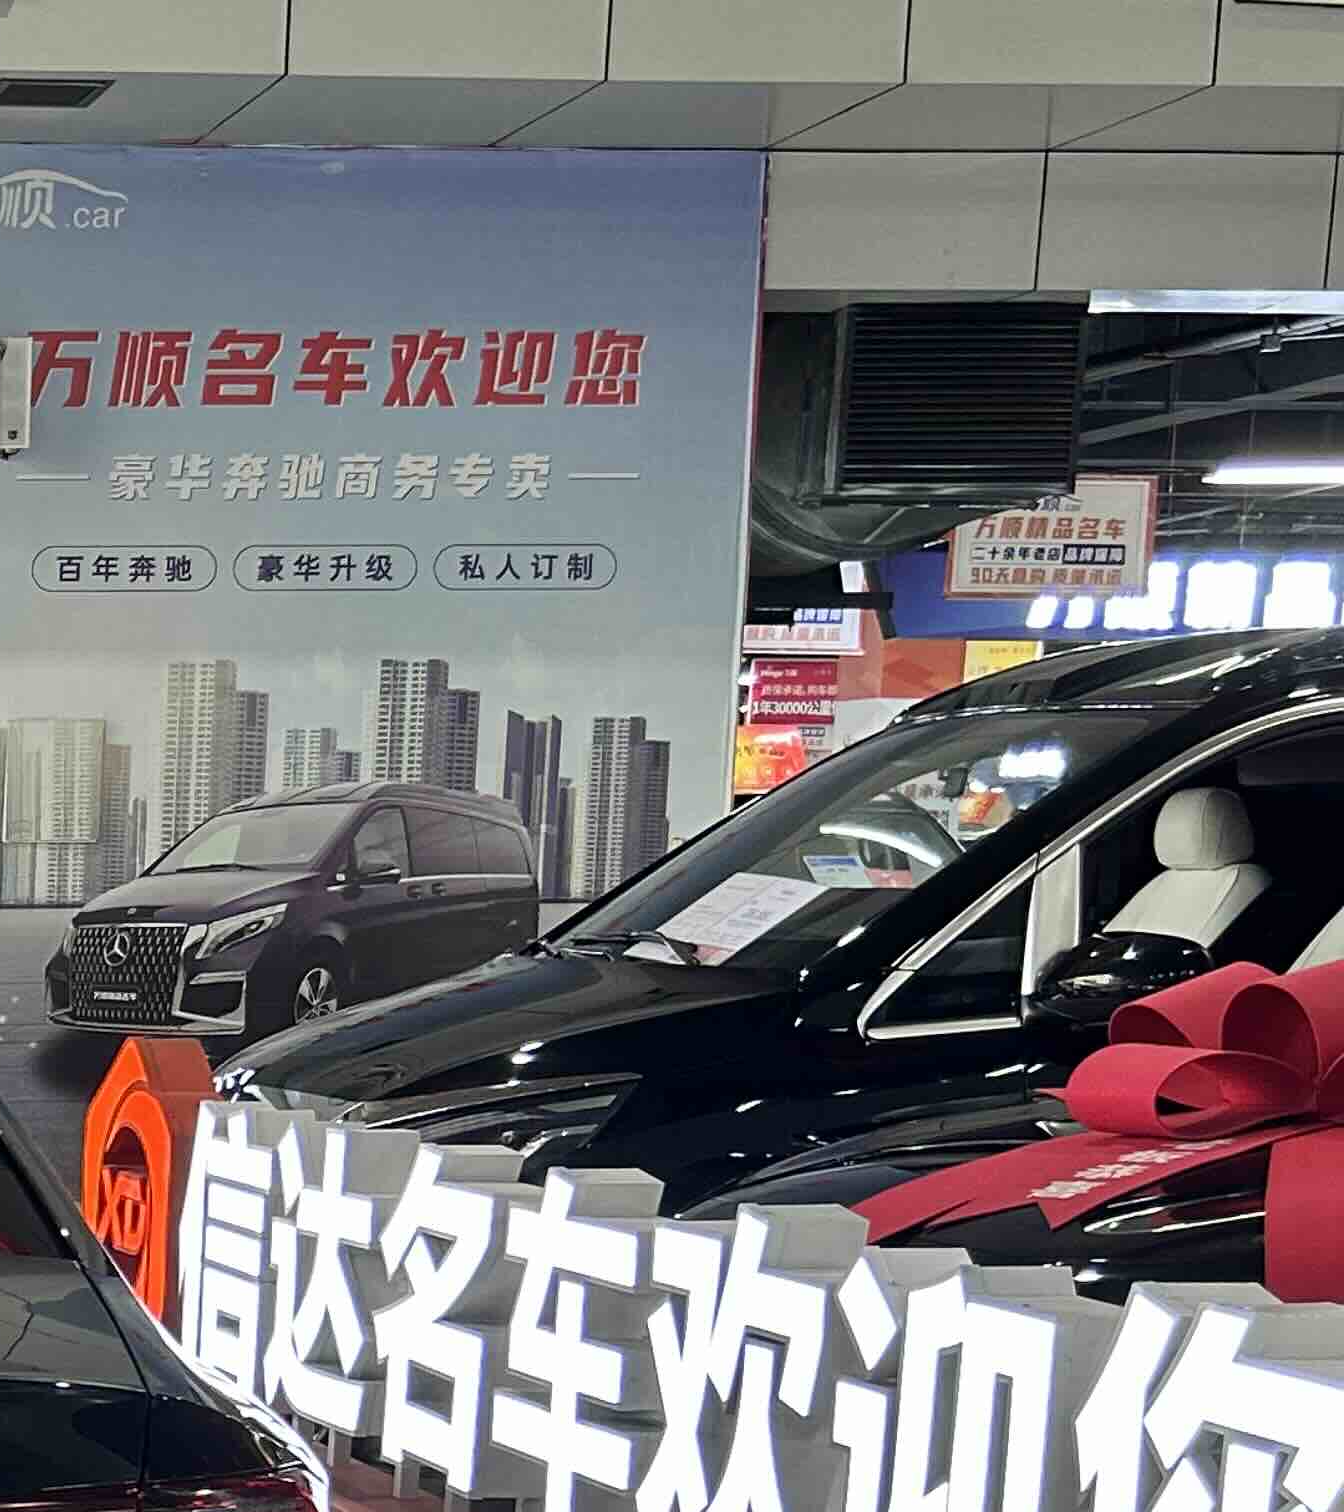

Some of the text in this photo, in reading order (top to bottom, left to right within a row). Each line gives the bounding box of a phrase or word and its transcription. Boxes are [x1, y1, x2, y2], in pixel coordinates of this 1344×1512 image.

[28, 328, 649, 410] 万顺名车欢迎您
[106, 453, 554, 504] 豪华奔驰商务专卖
[973, 515, 1127, 541] 万顺精品名车
[55, 554, 194, 584] 百年奔驰
[255, 553, 394, 584] 豪华升级
[458, 552, 596, 583] 私人订制
